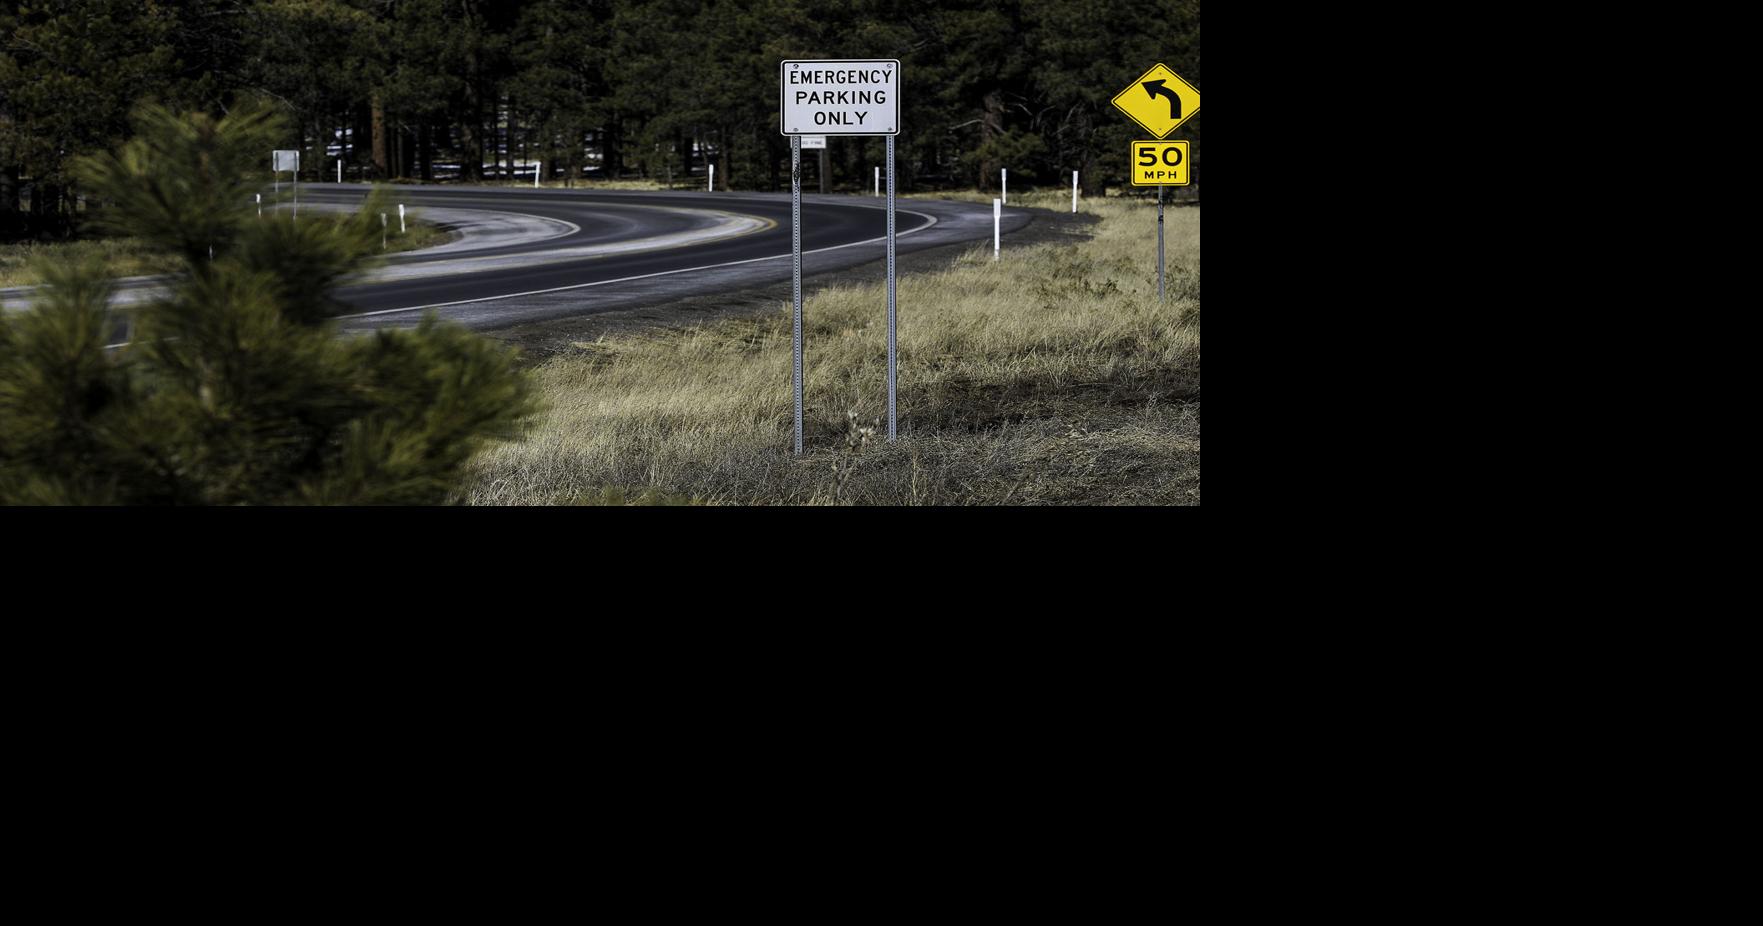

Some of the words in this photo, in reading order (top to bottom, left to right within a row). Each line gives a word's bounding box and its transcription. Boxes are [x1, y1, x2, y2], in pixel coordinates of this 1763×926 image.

[790, 70, 892, 84] EMERGENCY
[796, 91, 886, 105] PARKING
[814, 111, 868, 125] ONLY
[1138, 147, 1183, 167] 50
[1144, 170, 1177, 179] MPH
